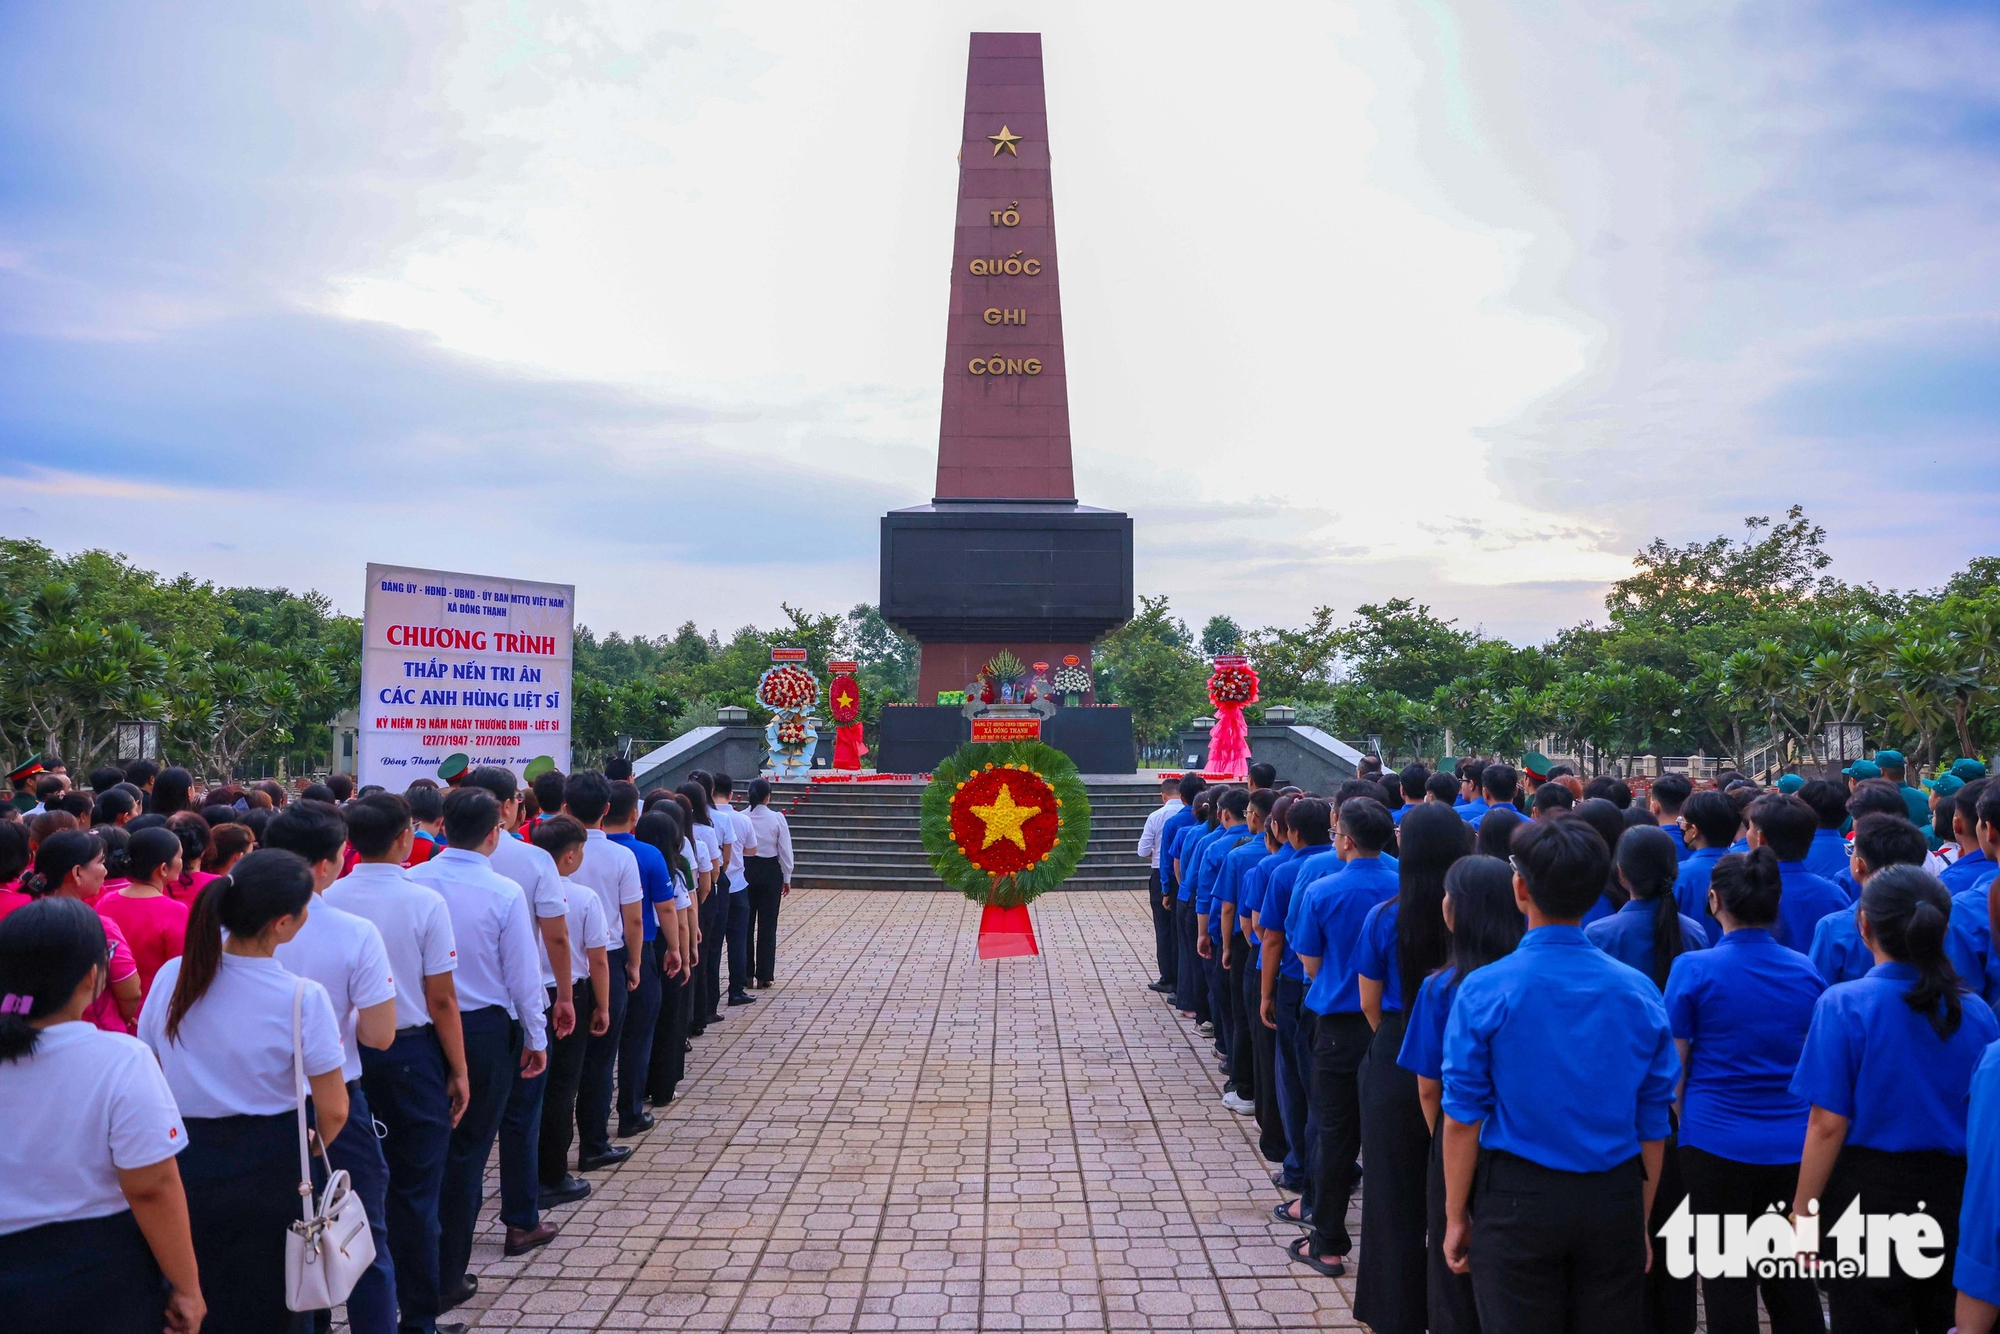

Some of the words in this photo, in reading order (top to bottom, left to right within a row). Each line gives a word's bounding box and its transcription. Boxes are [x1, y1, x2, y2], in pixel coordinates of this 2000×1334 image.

[990, 201, 1020, 227] TỔ
[969, 250, 1041, 276] QUỐC
[983, 308, 1026, 325] GHI
[968, 352, 1042, 375] CÔNG
[424, 586, 446, 596] HĐND
[454, 588, 475, 600] UBND
[494, 592, 508, 602] BAN
[510, 594, 530, 606] MTTQ
[532, 596, 547, 608] VIỆT
[549, 598, 564, 608] NAM
[482, 606, 506, 618] THẠNH
[386, 625, 486, 650] CHƯƠNG
[493, 630, 556, 655] TRÌNH
[404, 658, 448, 678] THẮP
[453, 660, 486, 680] NẾN
[490, 666, 515, 682] TRI
[519, 665, 541, 682] ÂN
[380, 686, 416, 704] CÁC
[420, 690, 457, 706] ANH
[462, 688, 508, 707] HÙNG
[514, 690, 542, 710] LIỆT
[546, 692, 560, 708] SĨ
[376, 715, 388, 729] KỶ
[391, 716, 413, 731] NIỆM
[416, 718, 426, 729] 79
[428, 717, 448, 729] NĂM
[450, 718, 472, 730] NGÀY
[474, 718, 506, 730] THƯƠNG
[508, 720, 528, 730] BINH
[534, 719, 550, 732] LIỆT
[422, 735, 468, 746] (27/7/1947
[476, 736, 520, 746] 27/7/2026)
[483, 756, 506, 766] tháng
